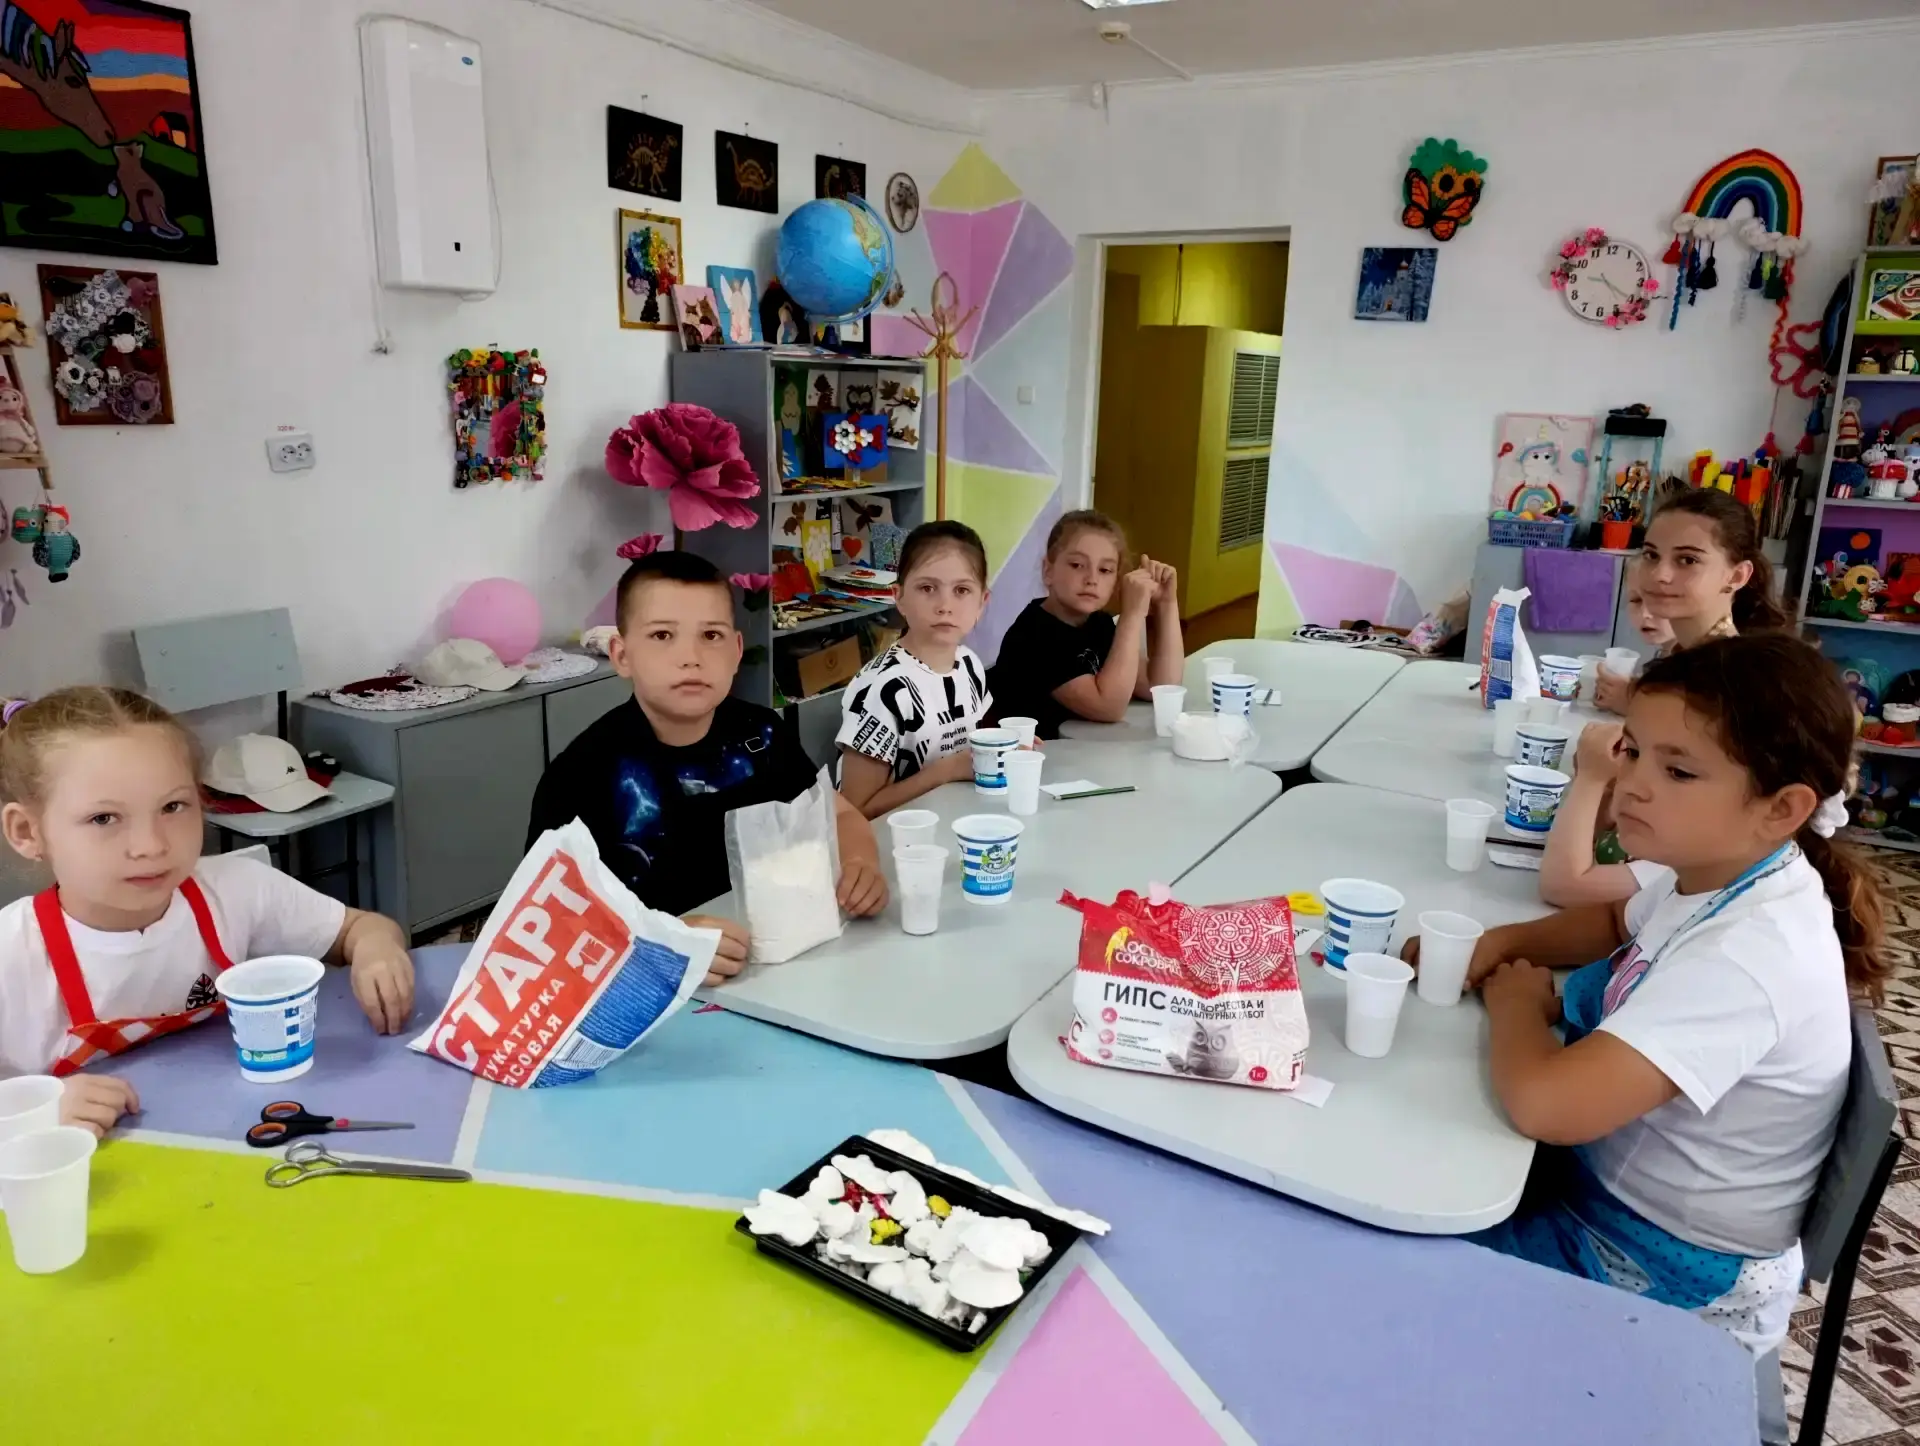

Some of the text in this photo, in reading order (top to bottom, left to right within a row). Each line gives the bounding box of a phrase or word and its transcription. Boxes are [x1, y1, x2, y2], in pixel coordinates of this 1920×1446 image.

[1591, 249, 1600, 258] 11
[1606, 245, 1619, 255] 12
[1627, 250, 1632, 259] 1
[1576, 259, 1588, 269] 10
[1636, 261, 1644, 272] 2
[1569, 274, 1577, 284] 9
[1637, 277, 1645, 287] 3
[1571, 290, 1578, 300] 8
[1627, 294, 1635, 304] 4
[1582, 303, 1588, 313] 7
[1596, 306, 1604, 317] 6
[1613, 304, 1620, 315] 5
[872, 724, 889, 746] BUT
[435, 860, 592, 1070] СТАРТ
[1103, 982, 1167, 1010] ГИПС
[1170, 995, 1264, 1013] ДЛЯ ТВОРЧЕСТВА И
[1238, 1010, 1265, 1020] РАБОТ
